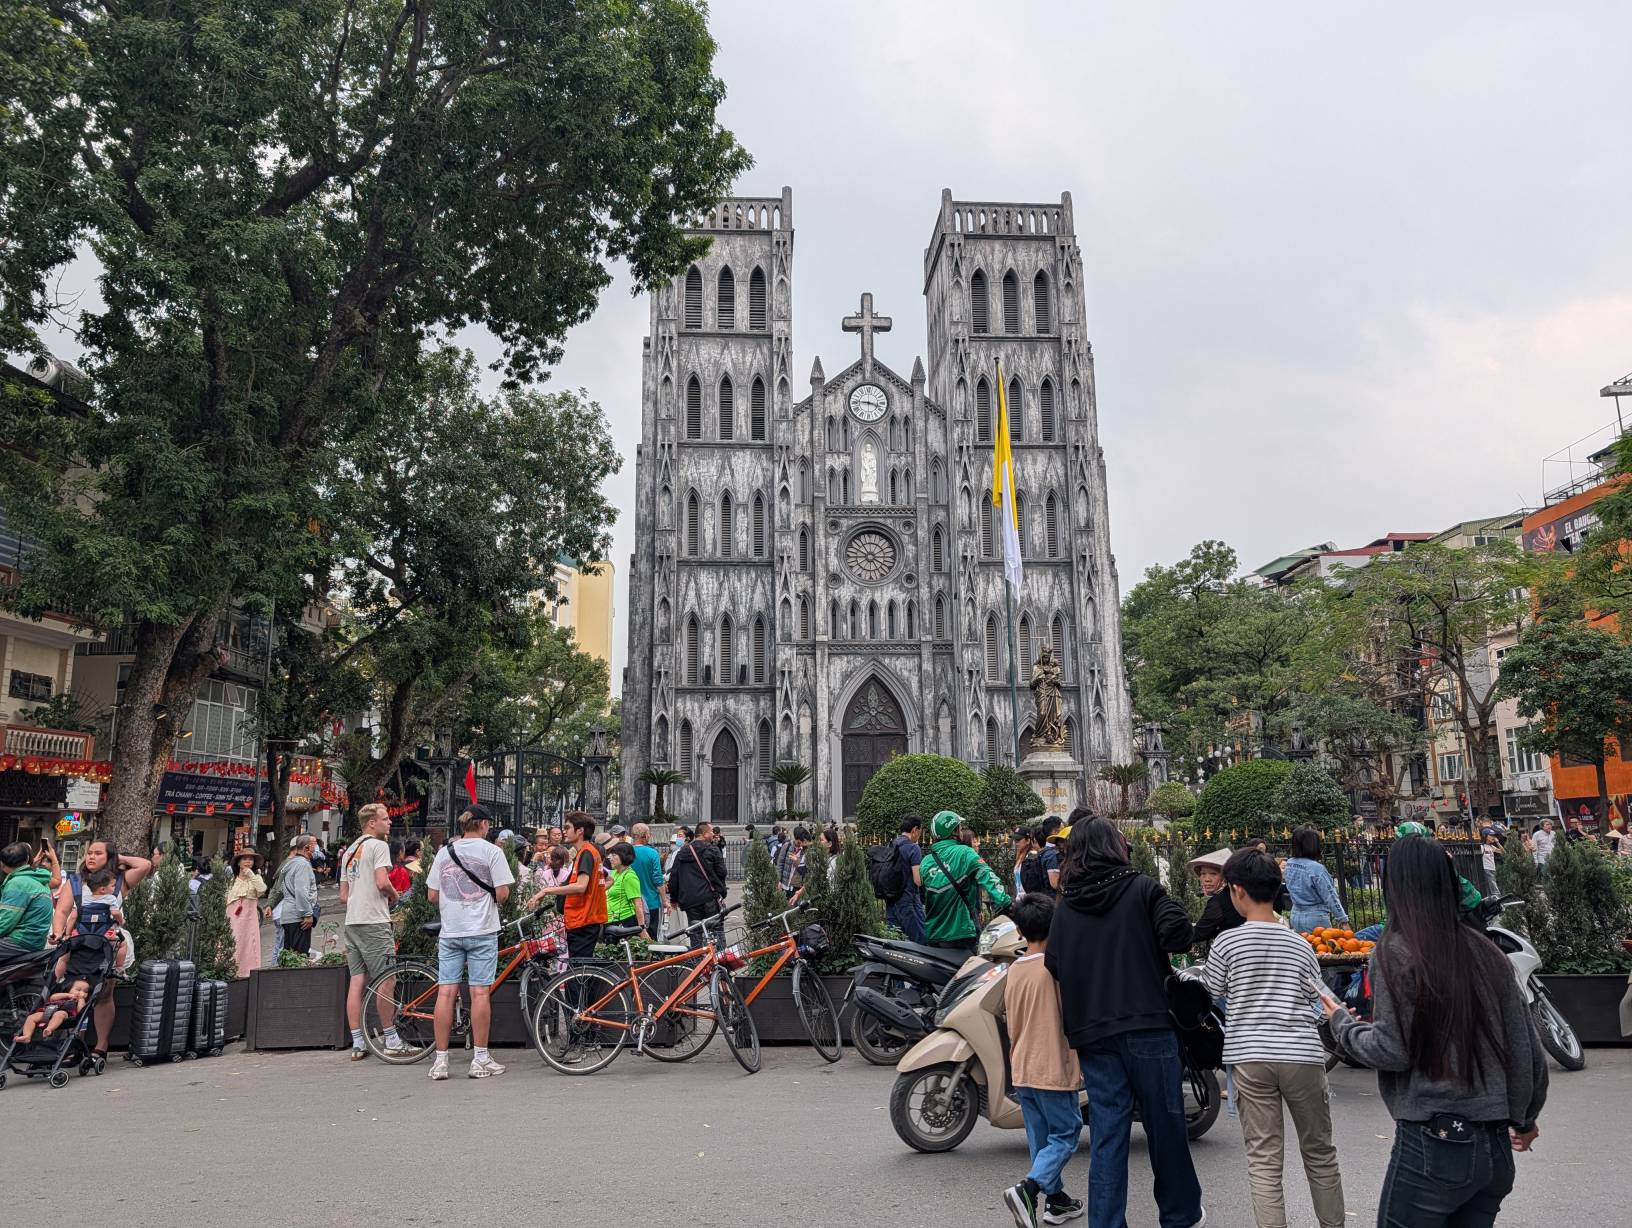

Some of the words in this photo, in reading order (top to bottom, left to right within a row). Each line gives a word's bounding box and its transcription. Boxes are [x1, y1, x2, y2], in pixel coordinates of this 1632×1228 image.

[1564, 521, 1573, 534] EL
[1573, 513, 1600, 530] GAUC
[195, 792, 213, 801] COFFEE
